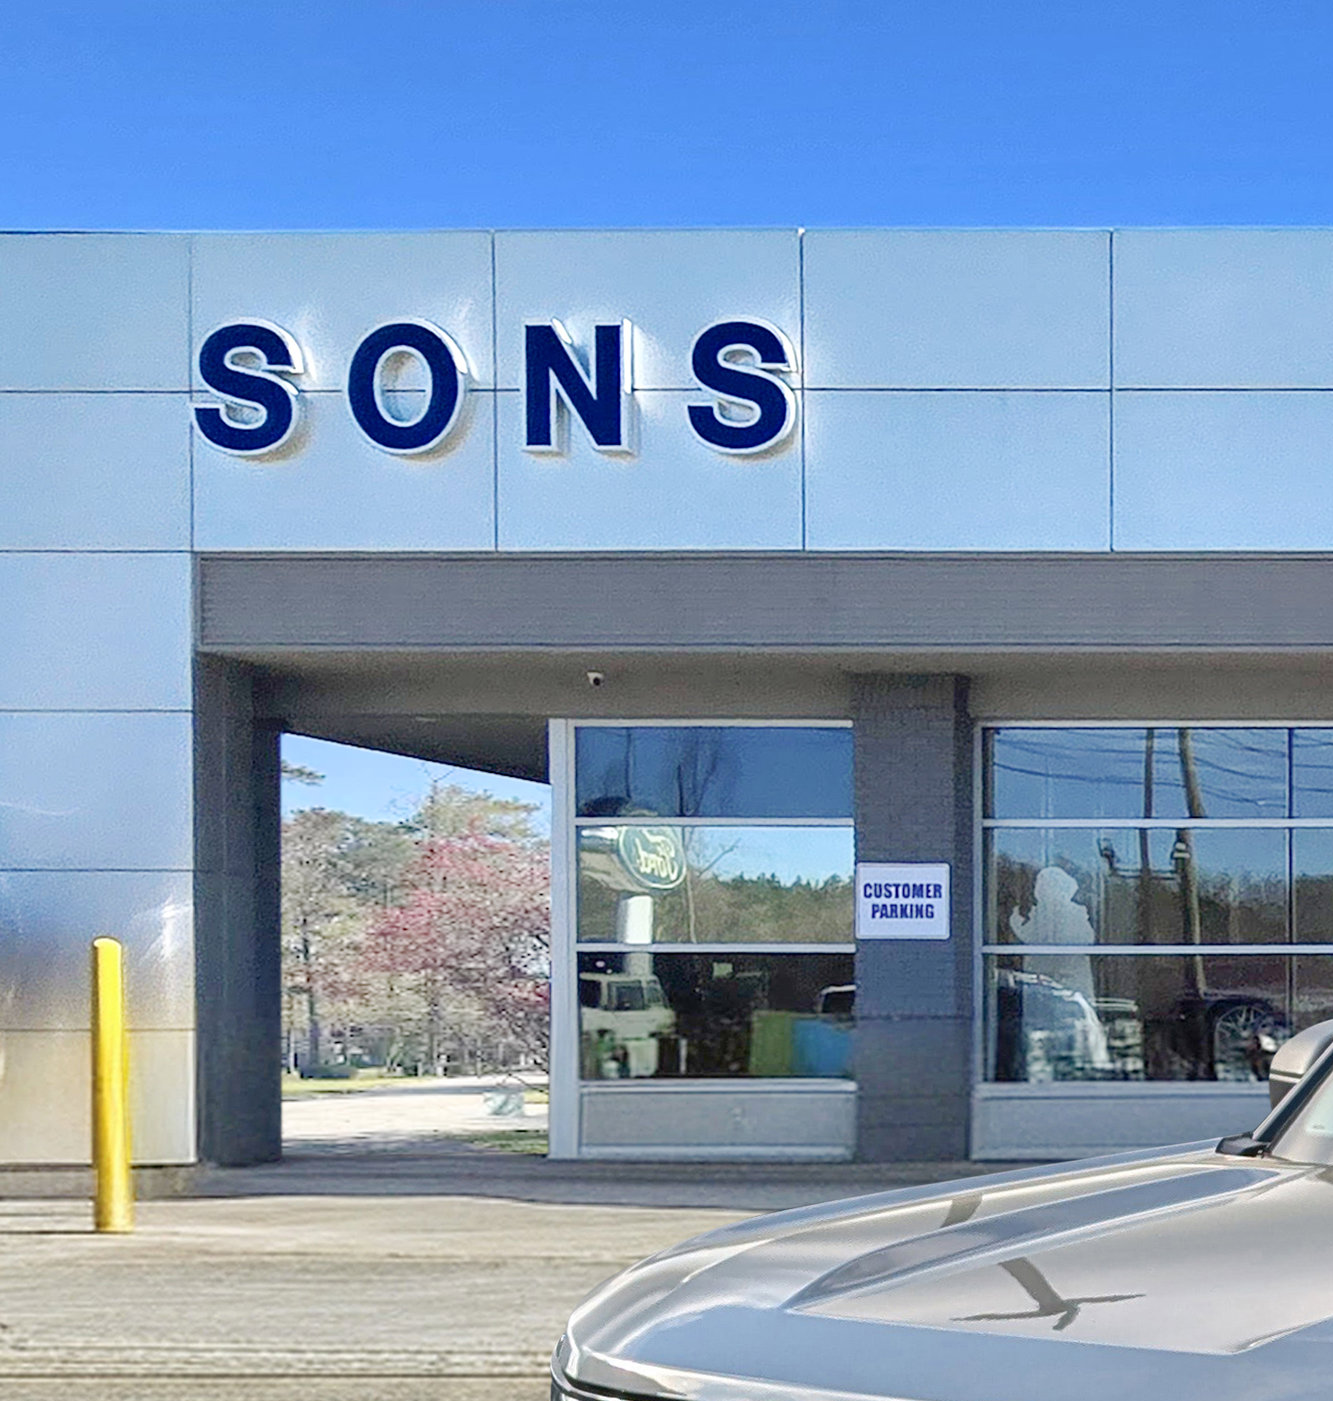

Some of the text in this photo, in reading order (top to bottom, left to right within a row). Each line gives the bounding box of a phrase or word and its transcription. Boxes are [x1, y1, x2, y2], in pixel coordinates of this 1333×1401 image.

[193, 318, 796, 454] SONS
[863, 883, 943, 899] CUSTOMER
[871, 903, 935, 919] PARKING
